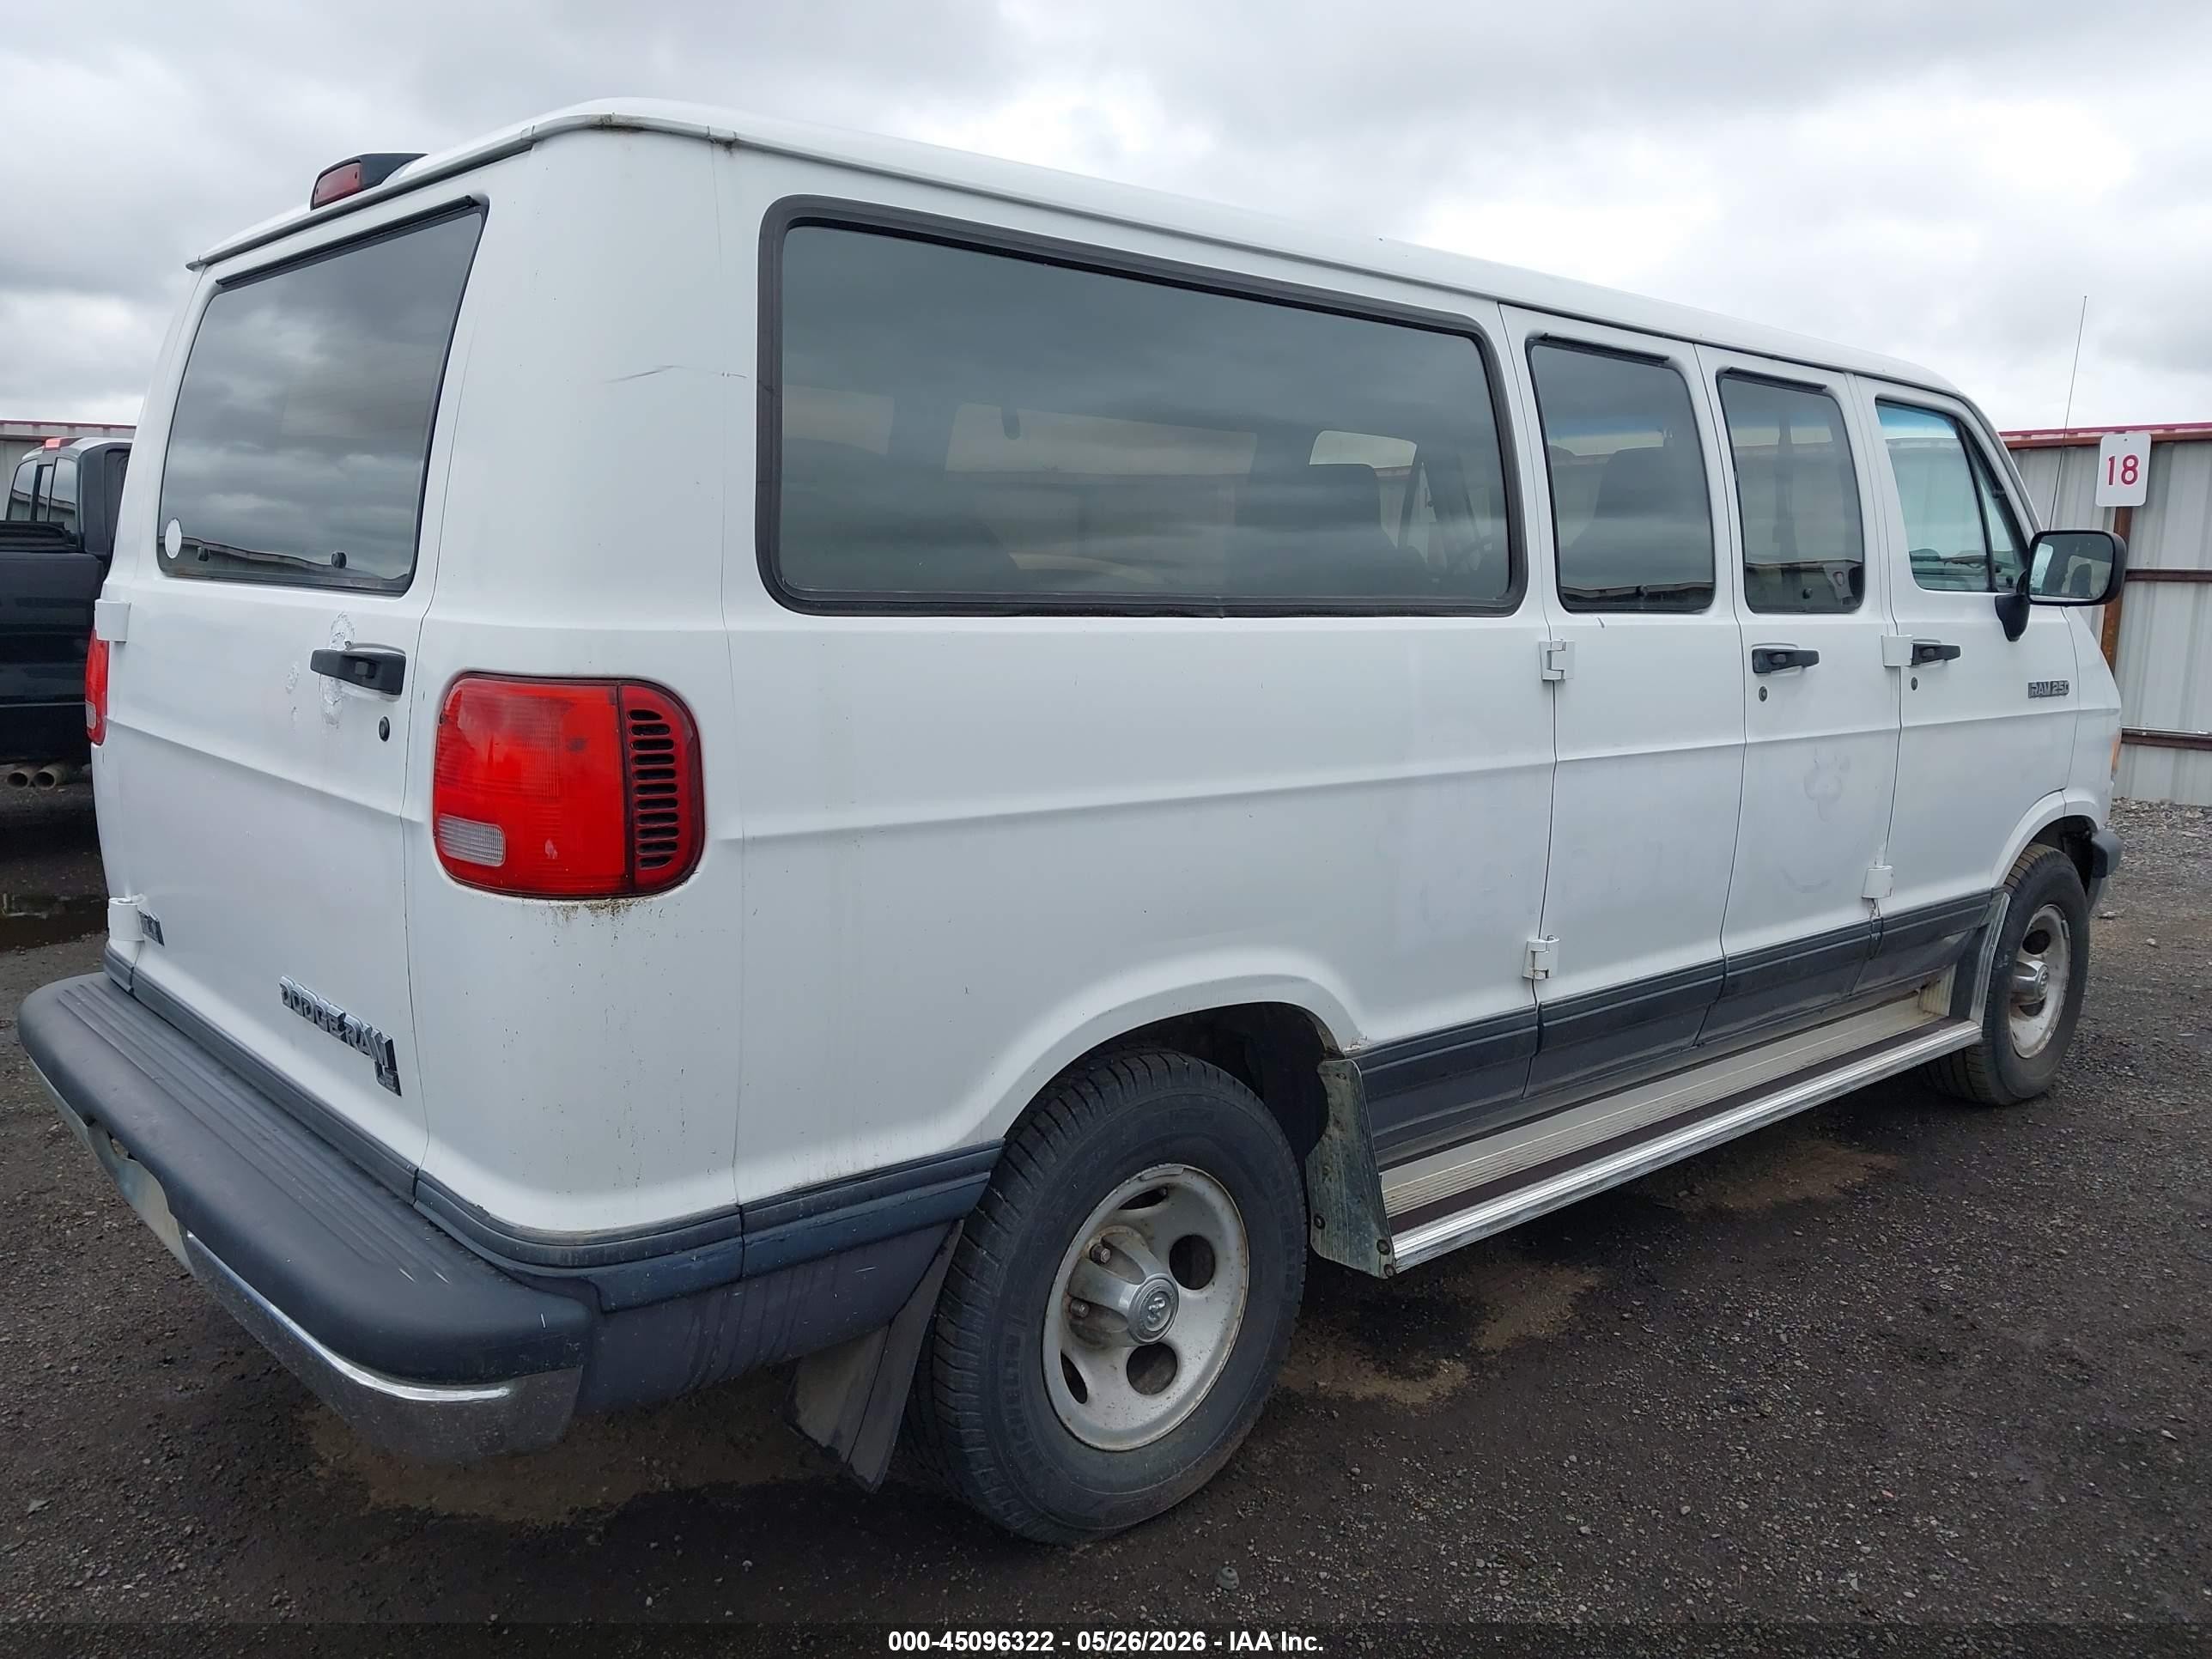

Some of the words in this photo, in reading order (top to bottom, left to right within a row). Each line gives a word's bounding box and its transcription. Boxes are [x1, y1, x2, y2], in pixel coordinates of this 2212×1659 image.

[2108, 454, 2139, 486] 18
[2029, 681, 2050, 697] RAM
[279, 975, 345, 1041] DODGE
[342, 1015, 398, 1073] RAM
